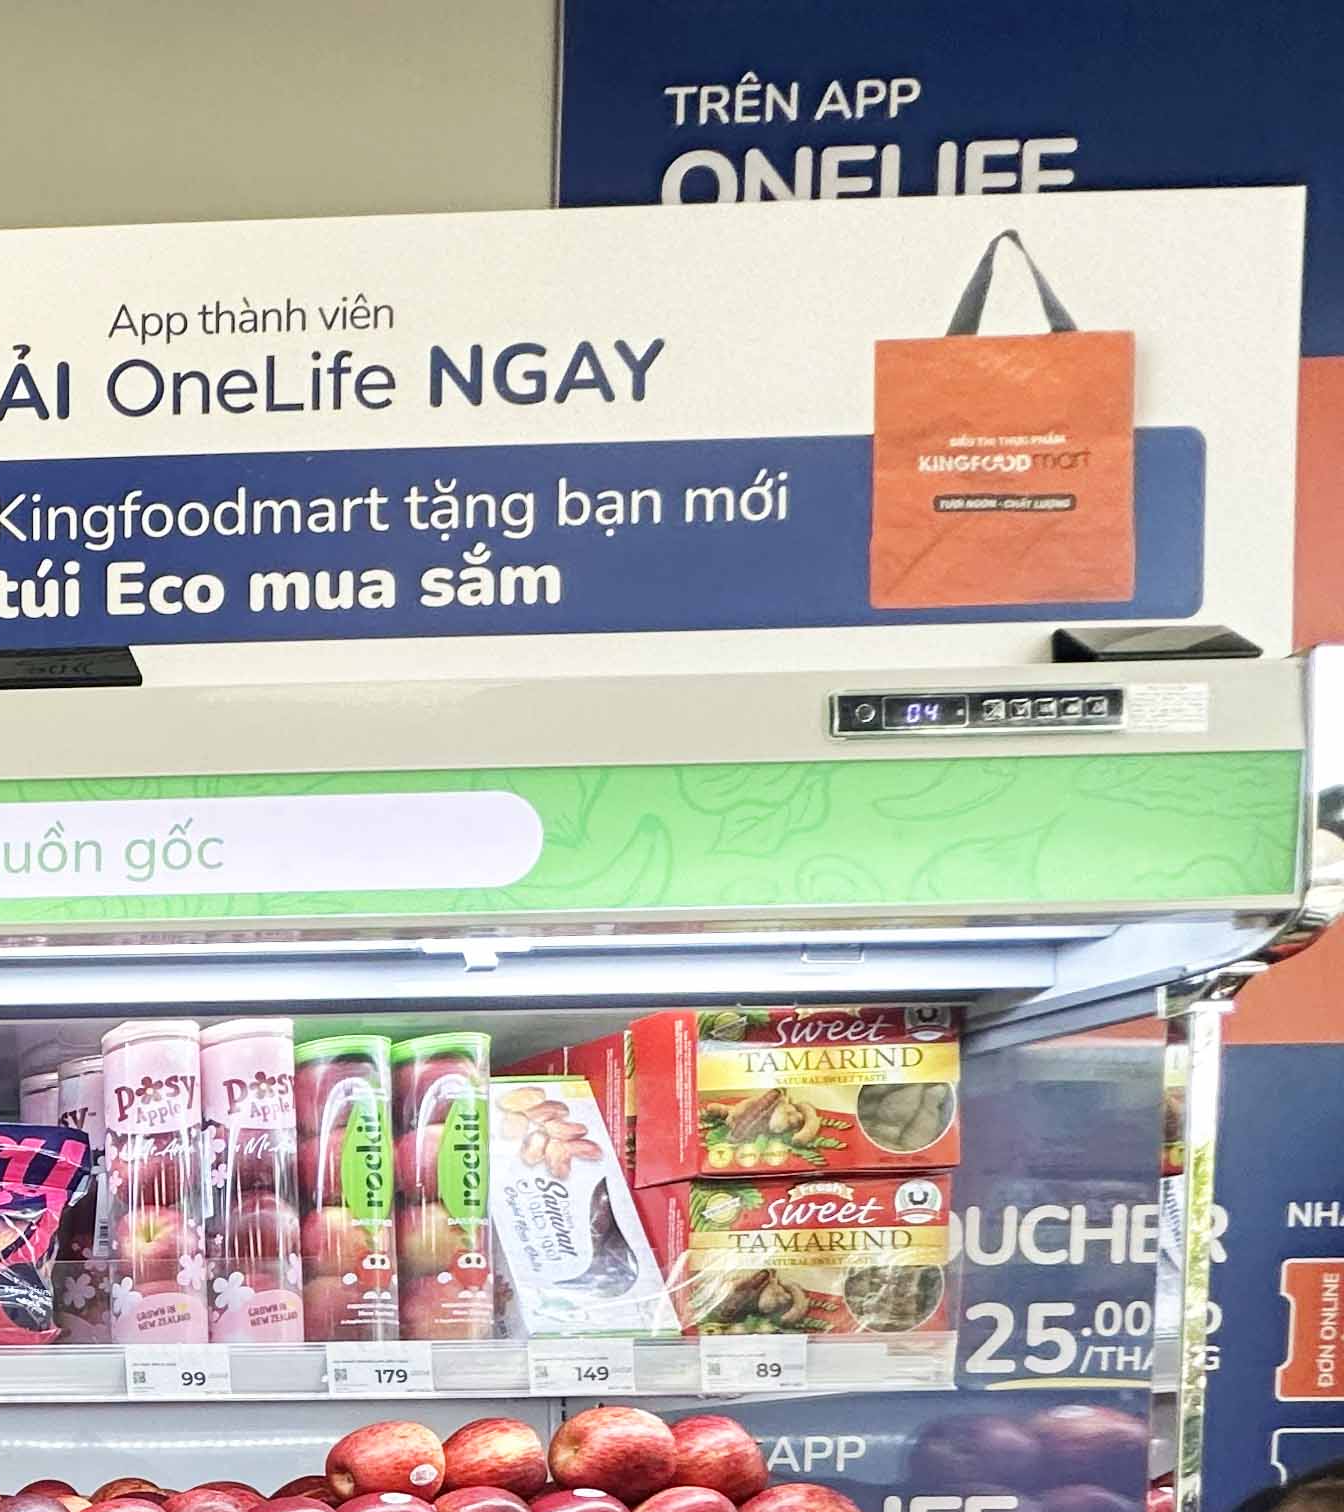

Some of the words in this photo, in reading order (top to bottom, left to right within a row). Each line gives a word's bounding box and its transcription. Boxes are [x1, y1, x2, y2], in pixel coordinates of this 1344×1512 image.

[665, 71, 799, 126] TRÊN
[815, 77, 921, 123] APP
[107, 302, 189, 346] App
[198, 298, 307, 335] thành
[319, 293, 394, 331] viên
[105, 352, 397, 416] OneLife
[428, 337, 665, 408] NGAY
[406, 478, 537, 541] tặng
[557, 478, 663, 539] bạn
[683, 472, 790, 521] mới
[104, 561, 227, 617] Eco
[248, 565, 397, 613] mua
[420, 543, 562, 608] sắm
[124, 817, 225, 882] gốc
[739, 1047, 924, 1073] TAMARIND
[365, 1110, 385, 1210] rockit
[461, 1110, 481, 1210] rockit
[729, 1230, 913, 1255] TAMARIND
[1319, 1272, 1341, 1336] ONLINE
[181, 1371, 206, 1387] 99
[375, 1368, 408, 1384] 179
[577, 1366, 609, 1382] 149
[756, 1362, 782, 1378] 89
[768, 1436, 867, 1472] APP
